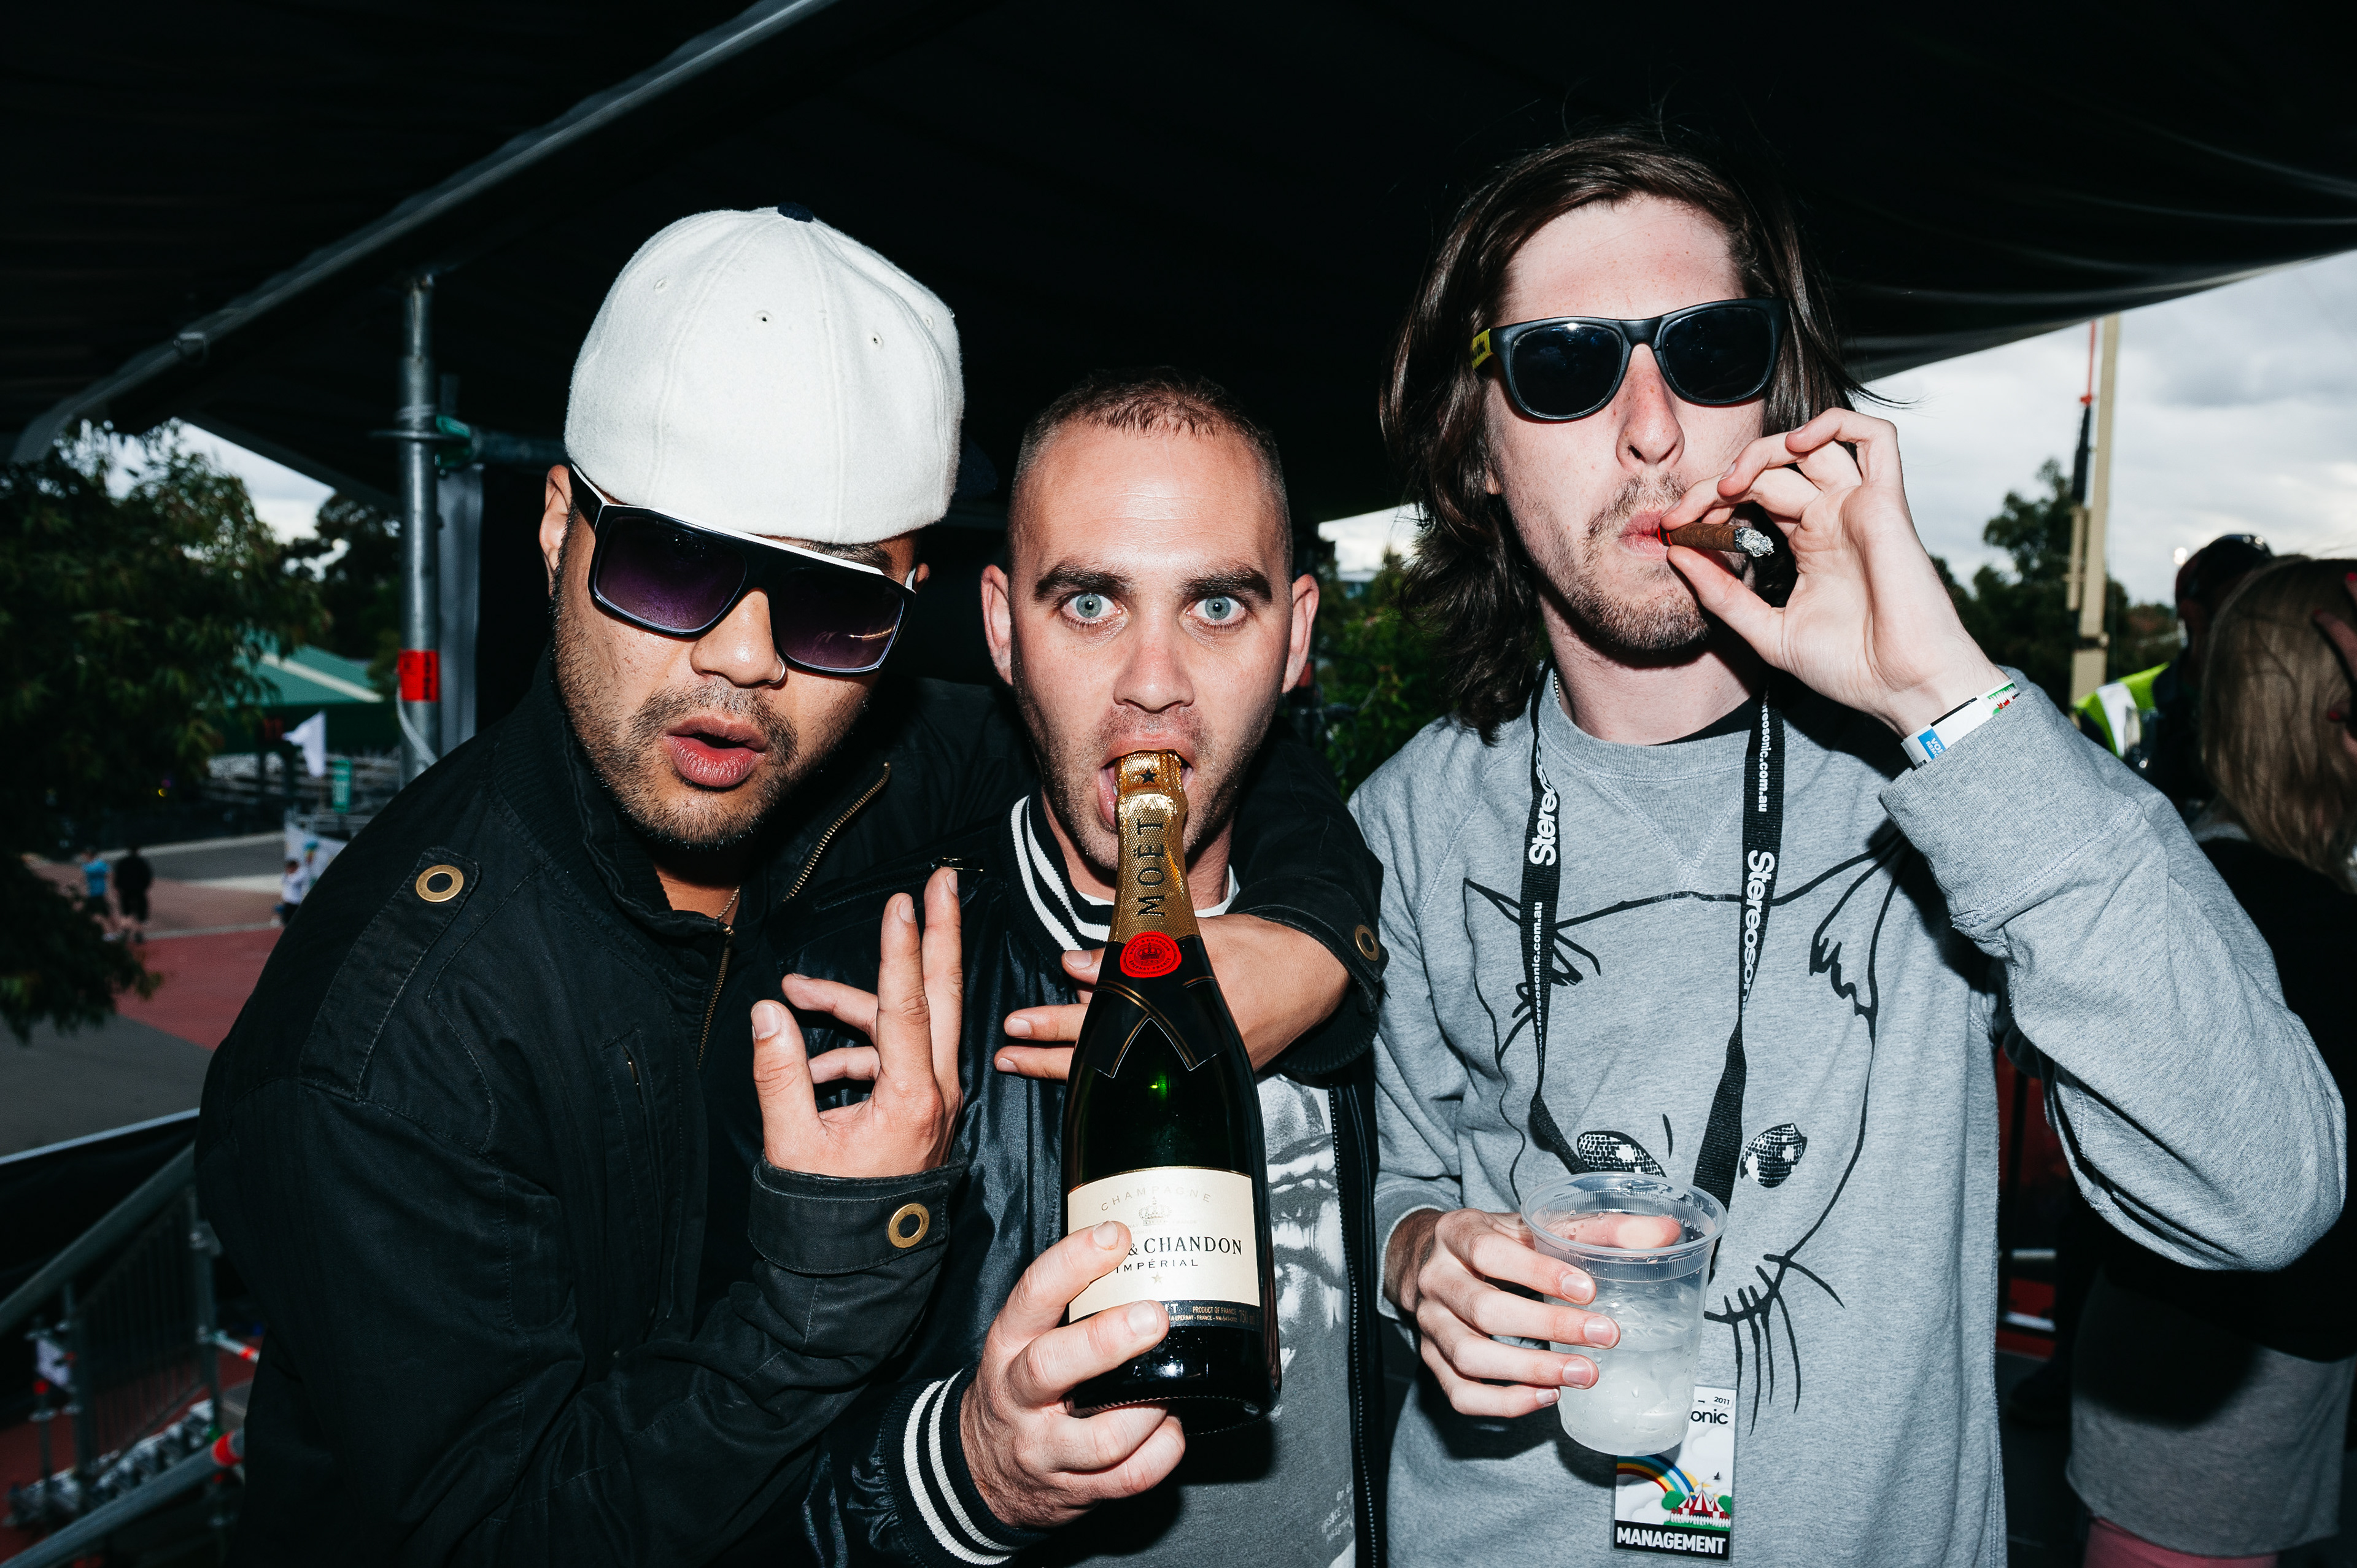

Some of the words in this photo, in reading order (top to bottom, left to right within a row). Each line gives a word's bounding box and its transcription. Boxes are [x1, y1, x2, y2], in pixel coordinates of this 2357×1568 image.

[1101, 1186, 1211, 1211] CHAMPAGNE
[1144, 1236, 1242, 1256] CHANDON
[1116, 1259, 1199, 1273] IMPÉRIAL
[1192, 1305, 1213, 1314] PRODUCT
[1221, 1307, 1237, 1315] FRANCE
[1714, 1396, 1730, 1405] 2011
[1616, 1526, 1726, 1554] MANAGEMENT
